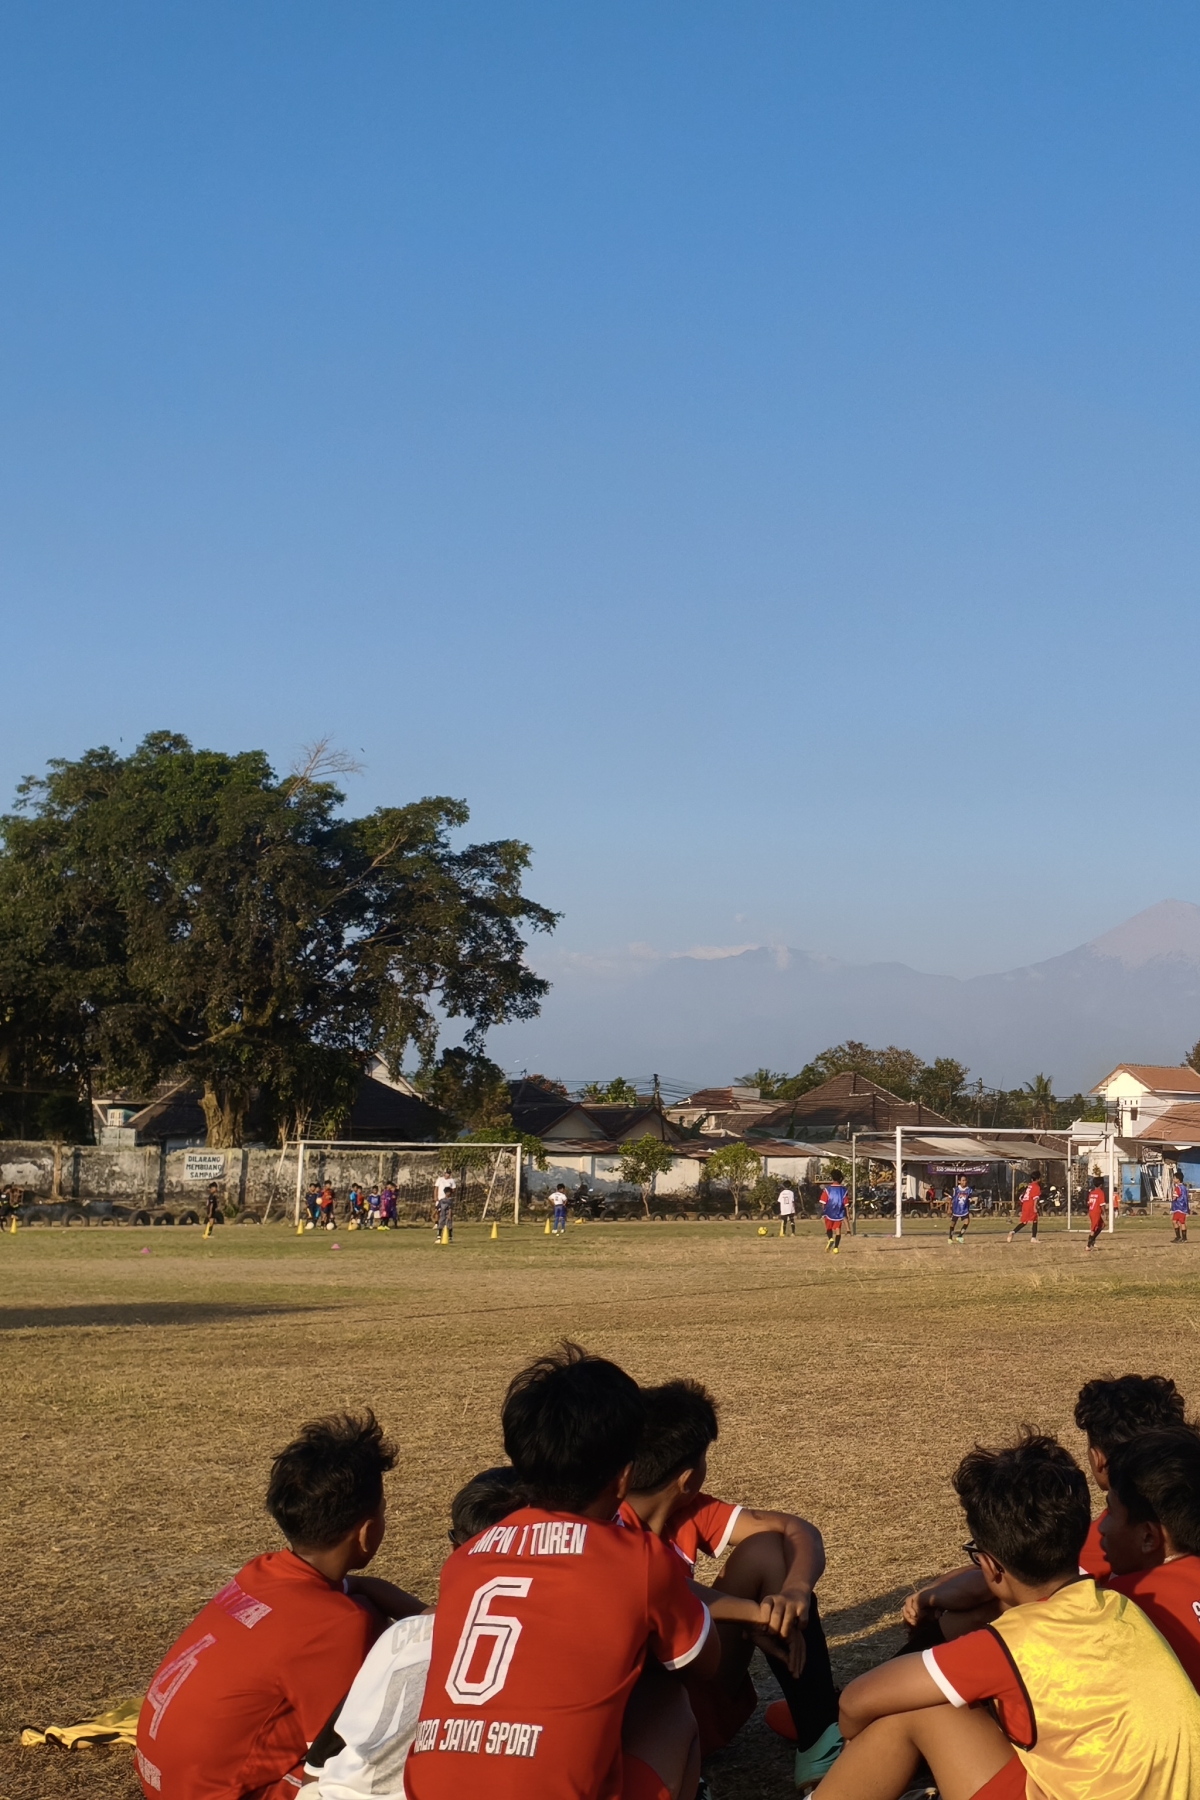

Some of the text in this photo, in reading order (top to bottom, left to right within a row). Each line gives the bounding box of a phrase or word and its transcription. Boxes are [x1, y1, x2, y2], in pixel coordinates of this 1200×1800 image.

[516, 1525, 530, 1556] 1
[530, 1521, 588, 1555] TUREN
[444, 1576, 534, 1706] 6
[147, 1632, 218, 1741] 4
[438, 1718, 485, 1754] JAYA
[485, 1721, 543, 1757] SPORT
